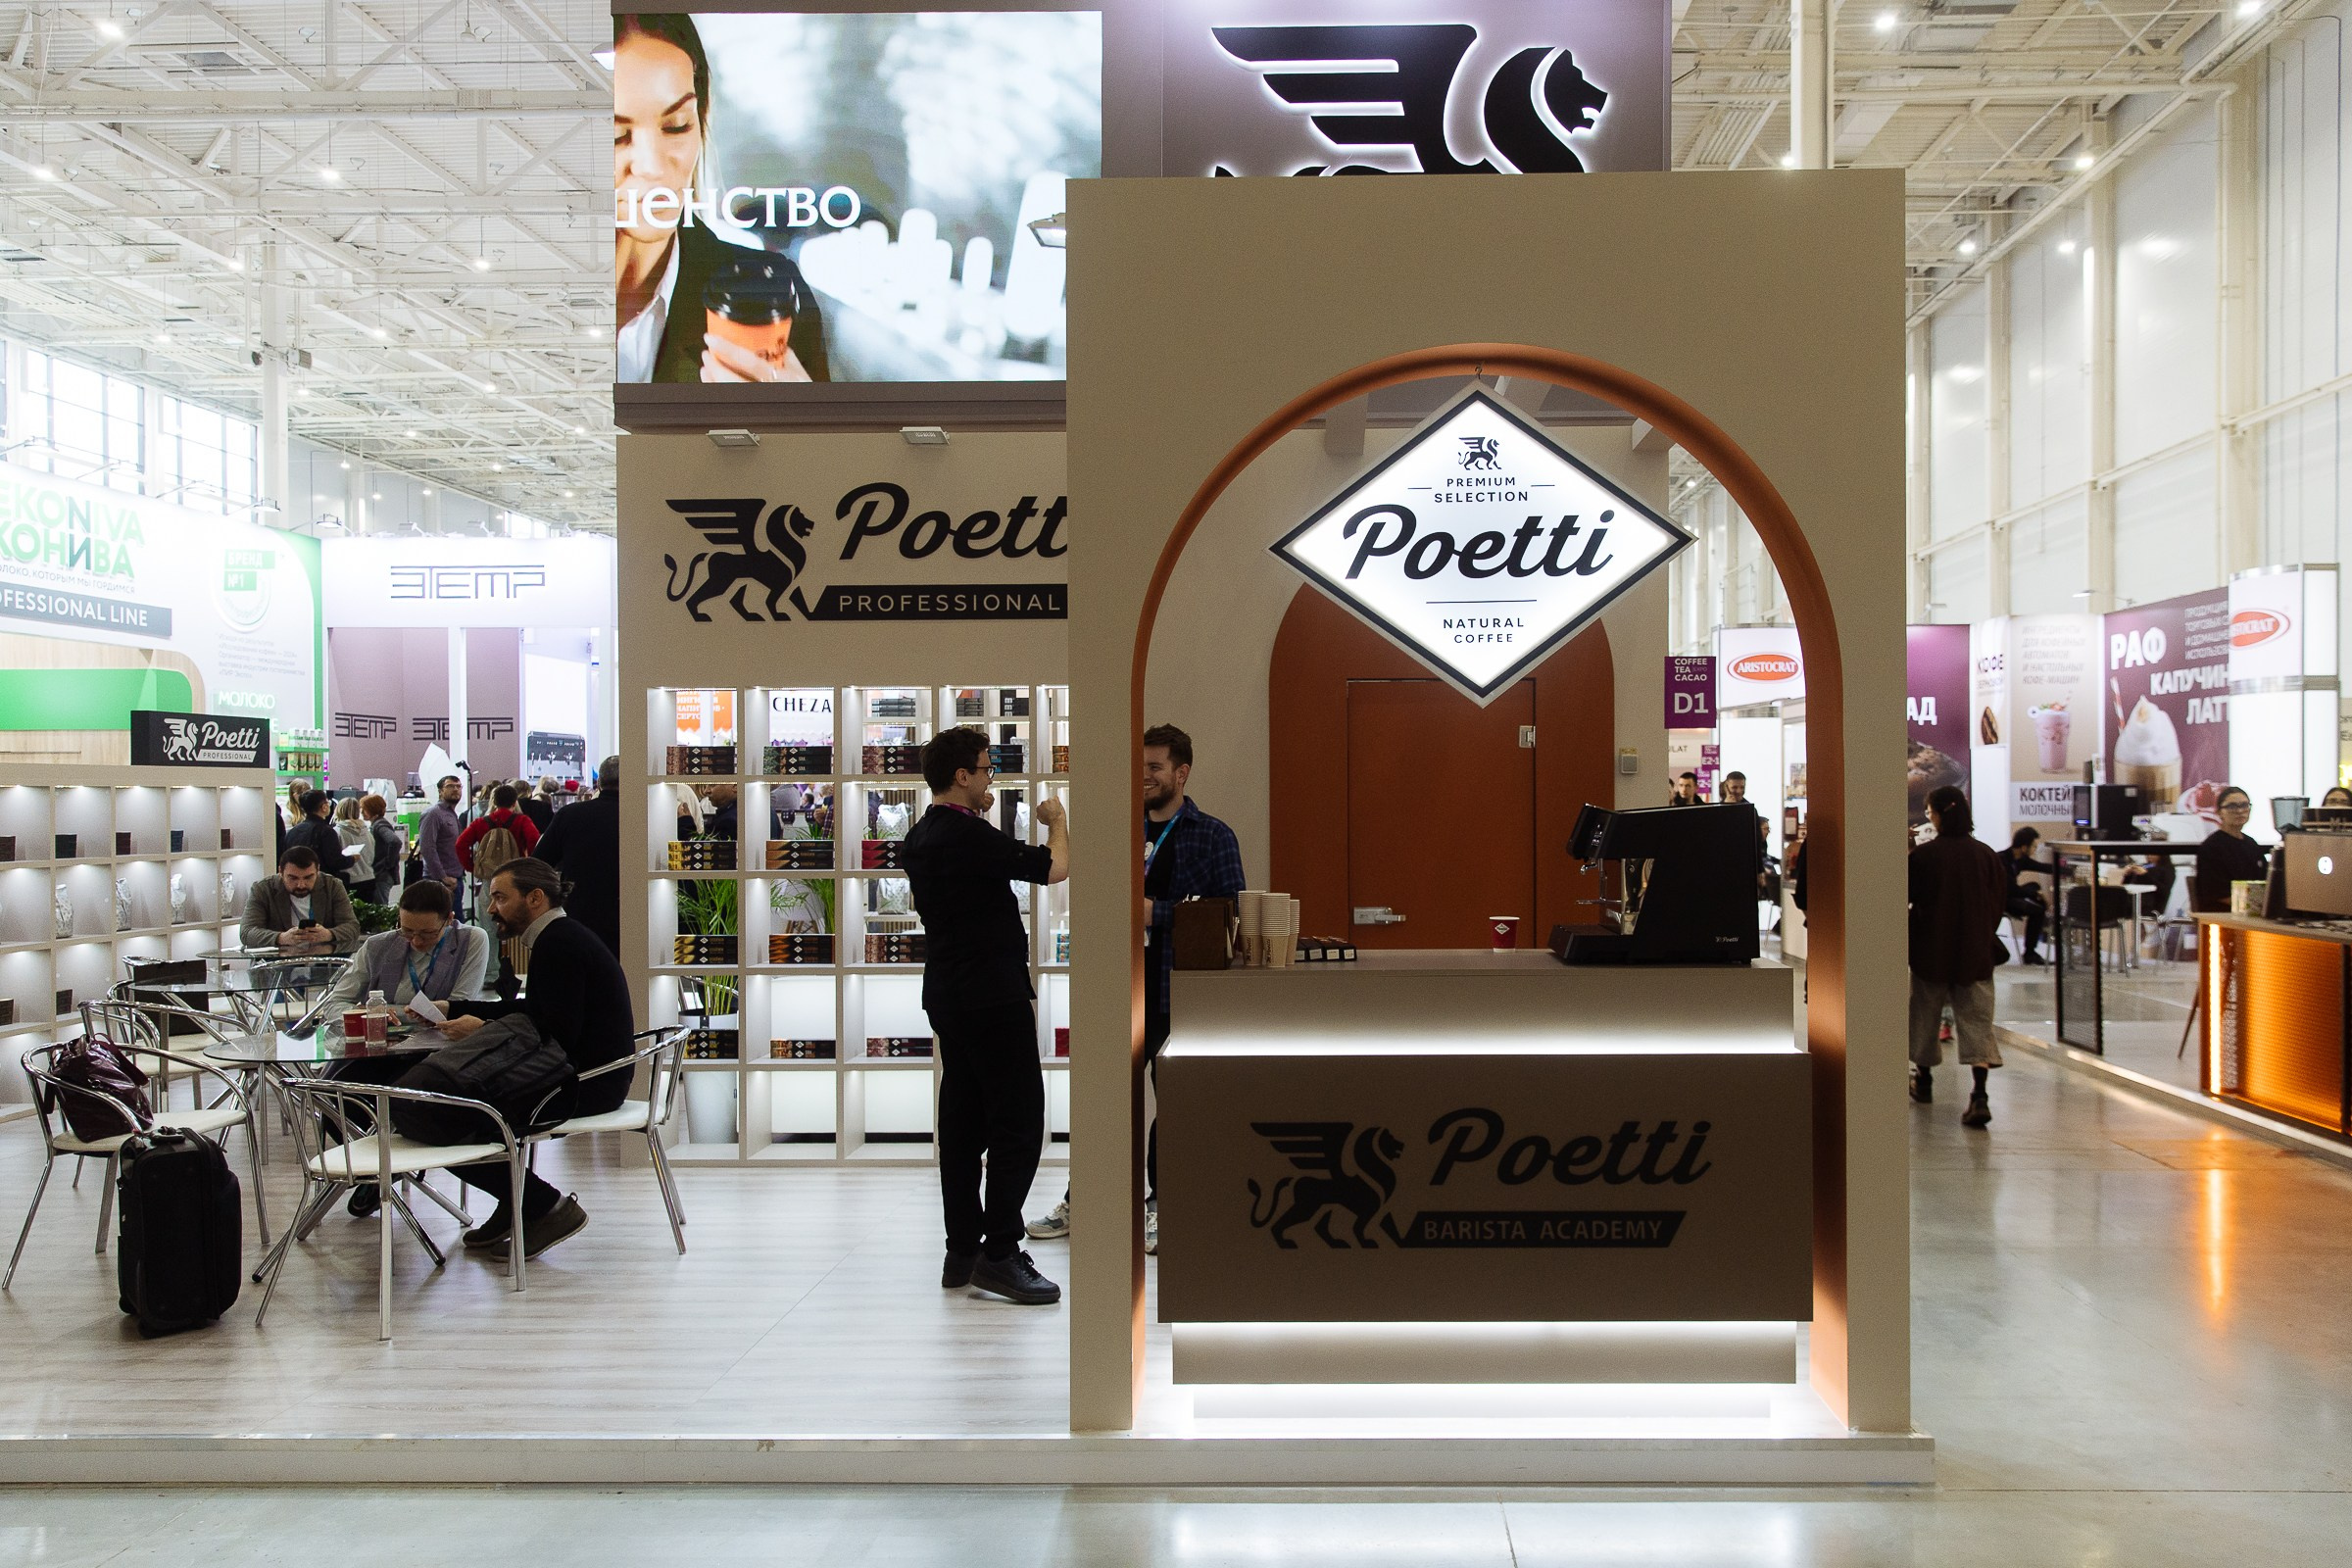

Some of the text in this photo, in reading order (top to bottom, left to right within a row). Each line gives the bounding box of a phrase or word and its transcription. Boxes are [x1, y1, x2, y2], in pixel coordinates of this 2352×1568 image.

[1446, 476, 1517, 488] PREMIUM
[1434, 491, 1529, 503] SELECTION
[1343, 503, 1616, 580] Poetti
[227, 552, 264, 567] БРЕНД
[32, 570, 75, 585] КОТОРЫМ
[77, 577, 92, 588] МЫ
[93, 580, 135, 594] ГОРДИМСЯ
[0, 588, 148, 627] FESSIONAL LINE
[839, 594, 1060, 612] PROFESSIONAL
[1443, 617, 1525, 629] NATURAL
[1453, 633, 1514, 644] COFFEE
[2110, 626, 2167, 670] РАФ
[1737, 661, 1797, 674] ARISTOCRAT
[218, 690, 275, 710] МОЛОКО
[772, 696, 832, 713] CHEZA
[1674, 692, 1708, 714] D1
[201, 720, 261, 749] Poetti
[202, 752, 252, 761] PROFESSIONAL
[1427, 1107, 1712, 1186] Poetti
[1424, 1219, 1663, 1241] BARISTA ACADEMY
